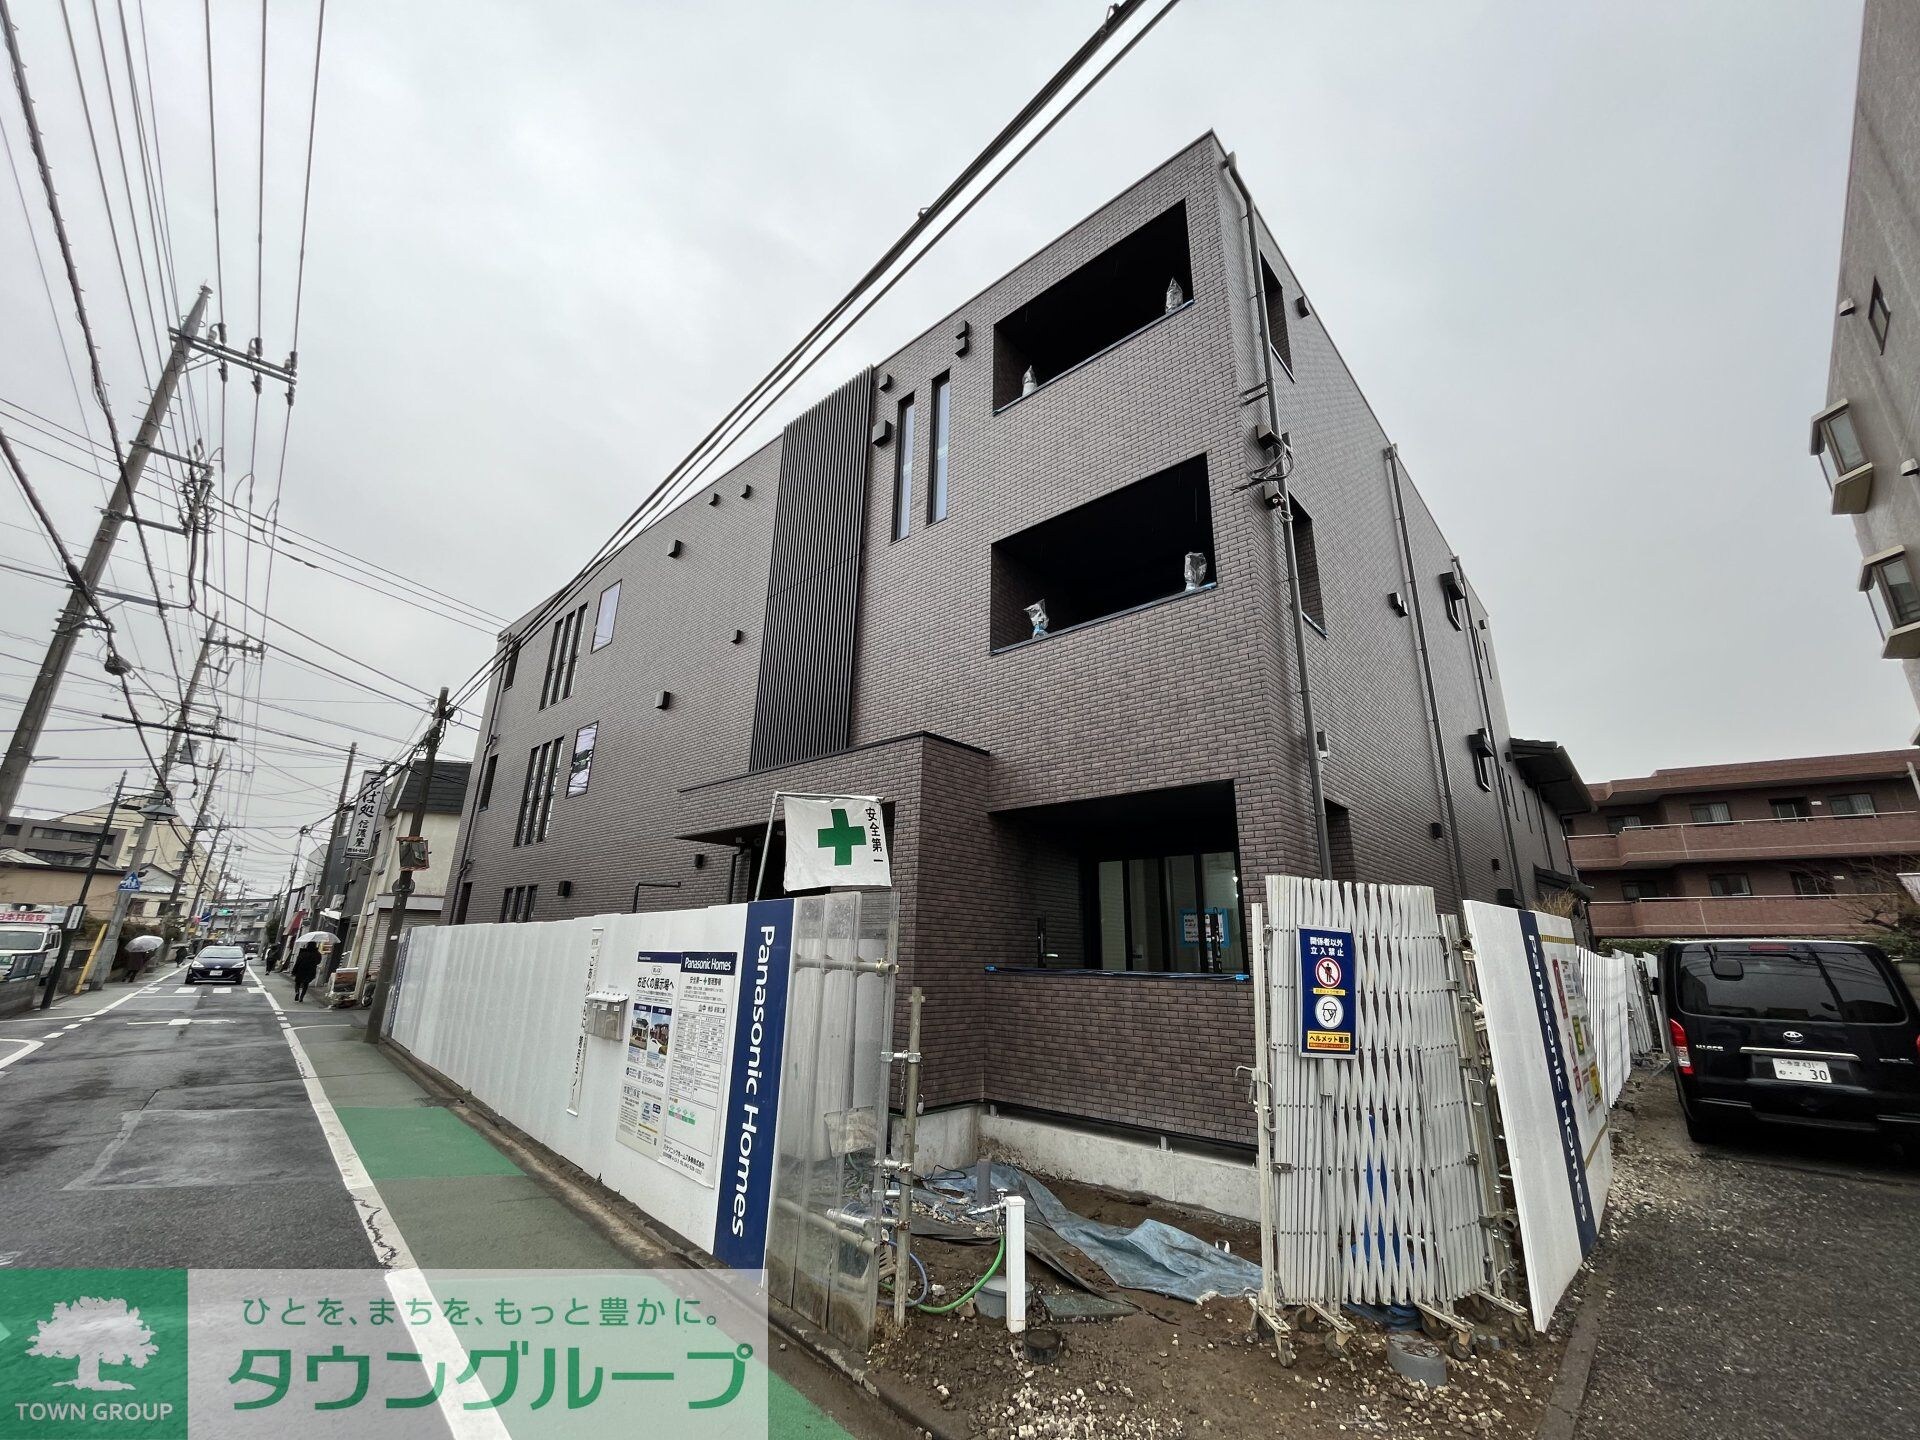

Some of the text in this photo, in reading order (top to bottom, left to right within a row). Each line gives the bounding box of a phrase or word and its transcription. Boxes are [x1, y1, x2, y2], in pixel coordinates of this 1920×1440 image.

[358, 777, 381, 818] そば処
[865, 807, 884, 862] 安全第一
[1309, 936, 1344, 948] 関係者以外
[1310, 946, 1344, 957] 立入禁止
[684, 957, 732, 971] Panasonic Homes
[732, 925, 776, 1238] Panasonic Homes
[1528, 934, 1565, 1093] Panasonic
[1561, 1100, 1588, 1222] Homes
[1810, 1069, 1828, 1081] 30
